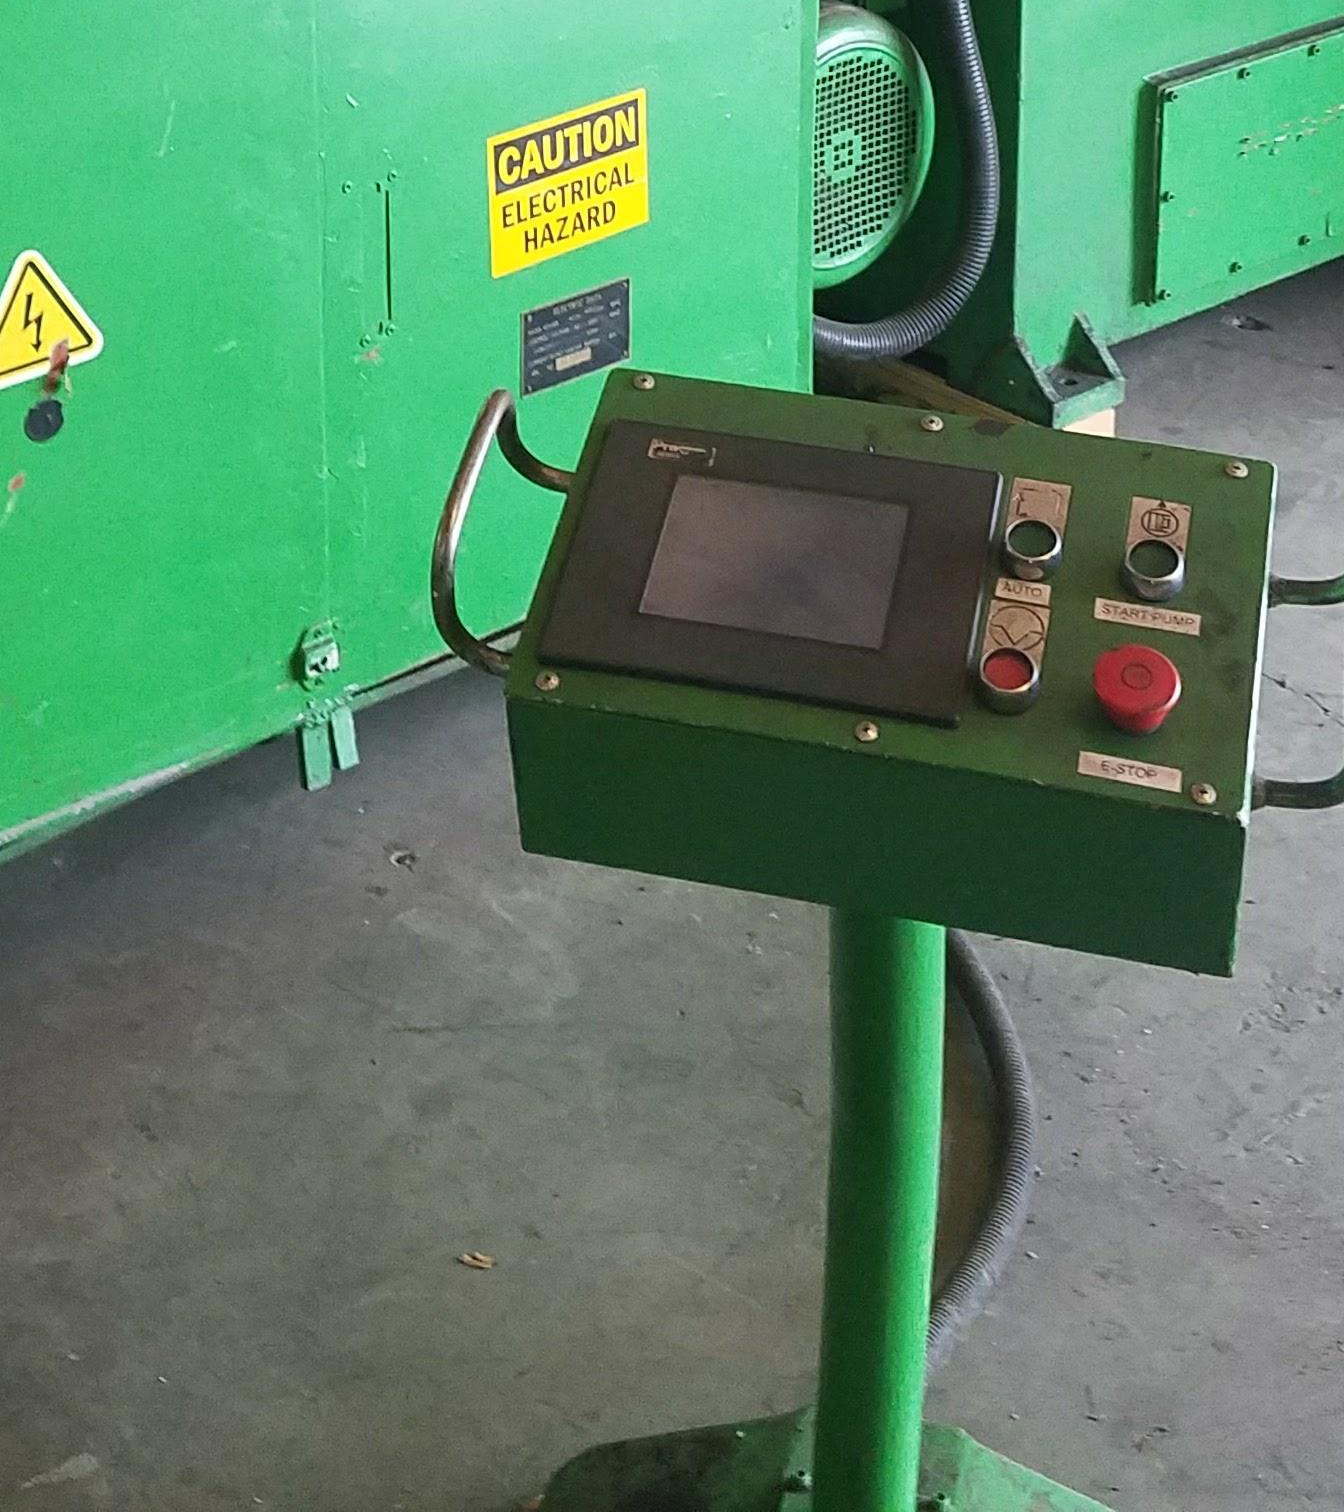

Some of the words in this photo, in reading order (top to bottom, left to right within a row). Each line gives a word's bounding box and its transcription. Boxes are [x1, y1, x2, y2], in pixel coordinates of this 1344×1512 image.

[498, 106, 637, 185] CAUTION
[501, 162, 635, 229] ELECTRICAL
[524, 200, 617, 254] HAZARD
[1001, 580, 1043, 597] AUTO
[1101, 603, 1150, 620] START
[1151, 611, 1195, 626] PUMP
[1100, 759, 1159, 780] E-STOP
